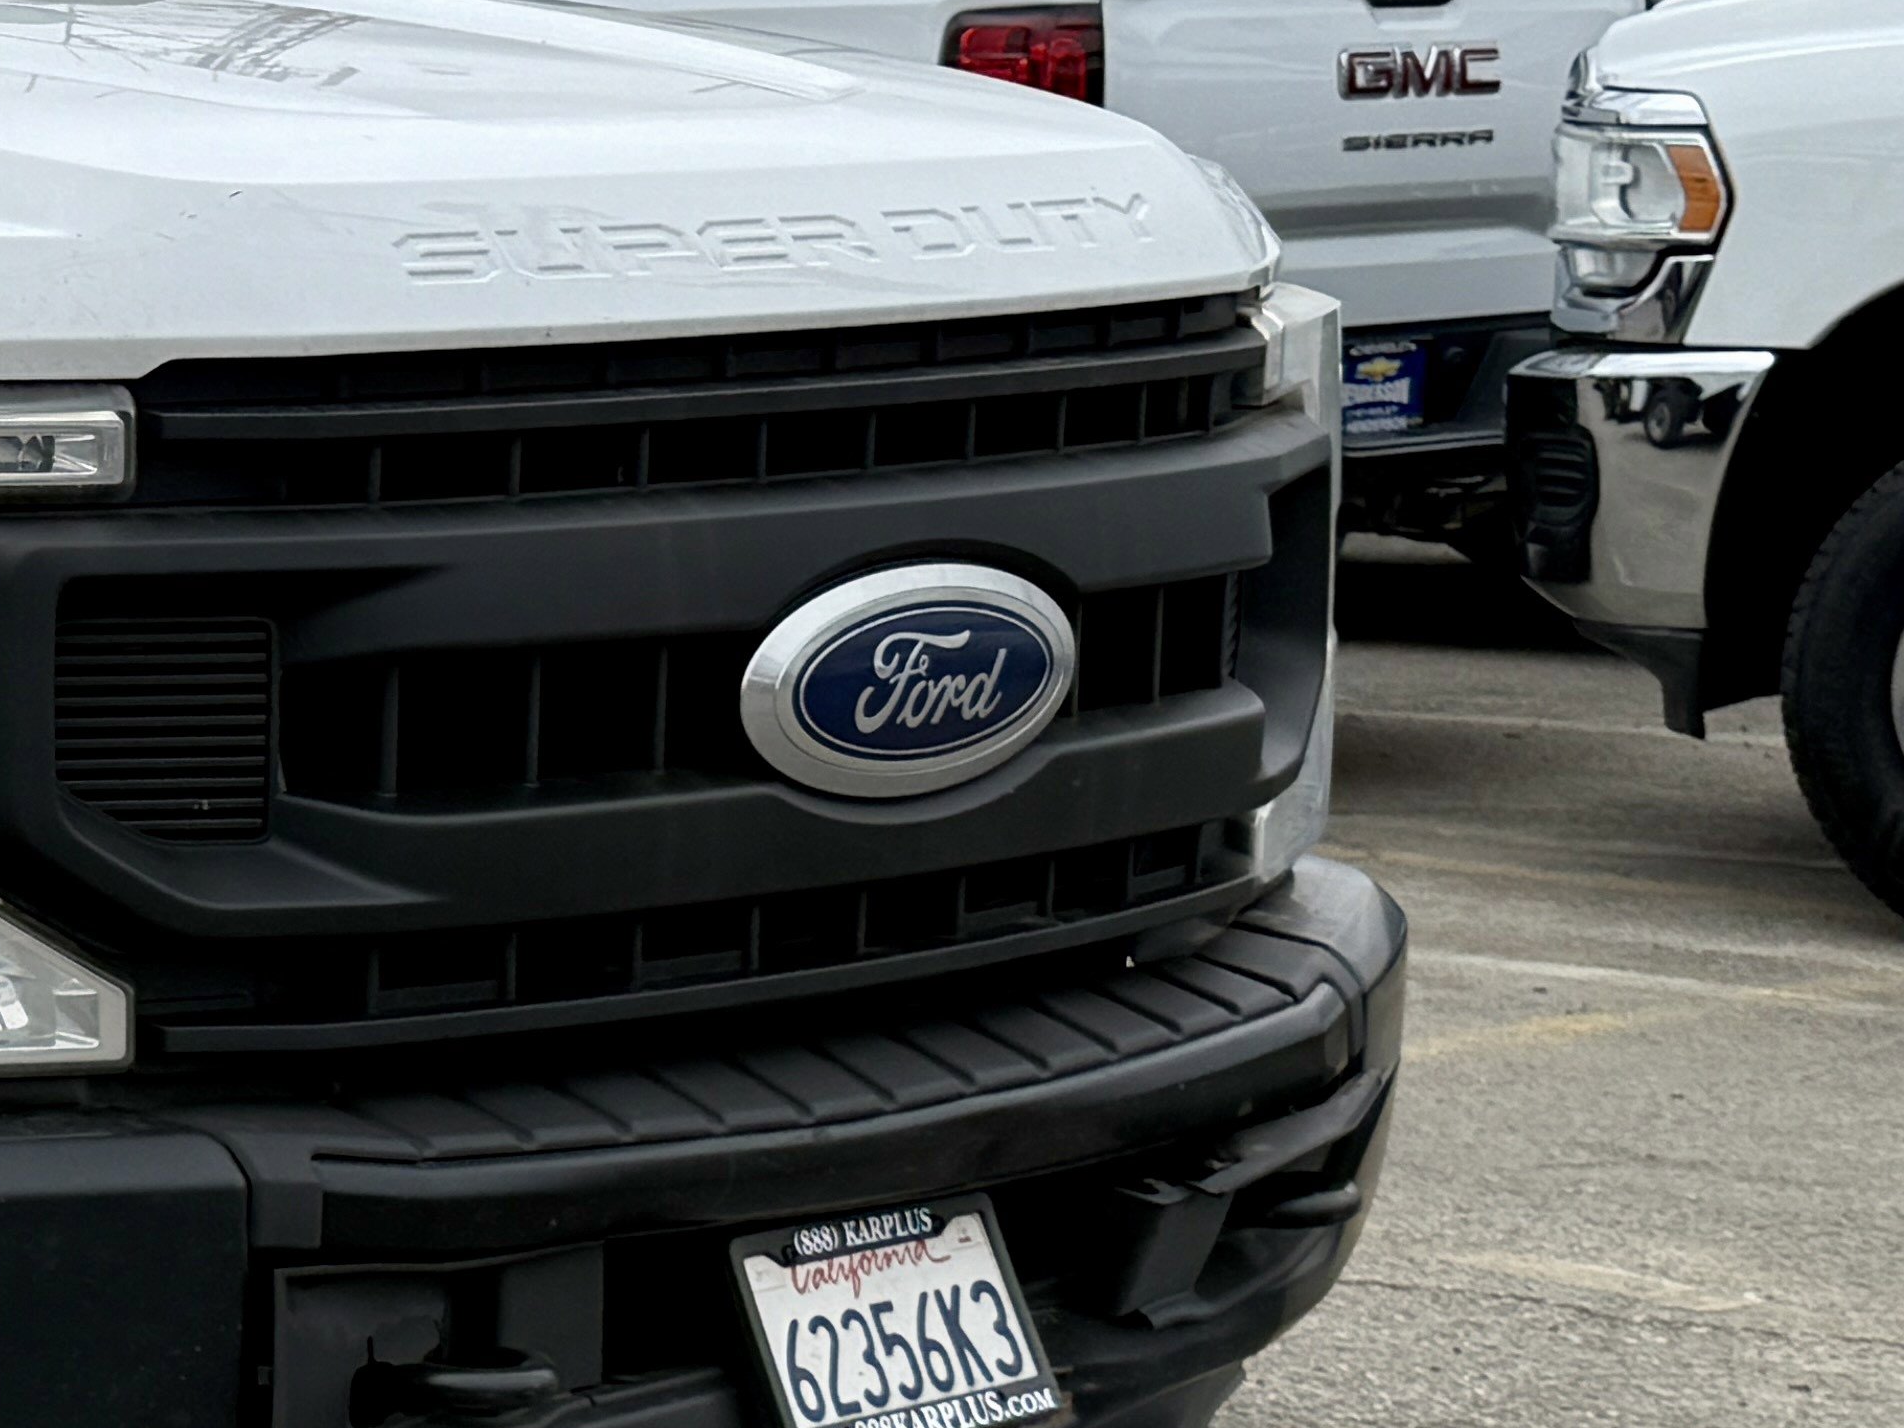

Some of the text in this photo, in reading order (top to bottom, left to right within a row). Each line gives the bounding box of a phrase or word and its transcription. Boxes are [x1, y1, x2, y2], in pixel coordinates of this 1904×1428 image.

[1338, 44, 1501, 100] GMC
[1342, 129, 1494, 152] SIERRA
[392, 190, 1152, 285] SUPER DUTY
[854, 629, 1007, 734] Ford
[793, 1207, 932, 1256] (888) KARPLUS
[786, 1279, 1024, 1423] 62356K3
